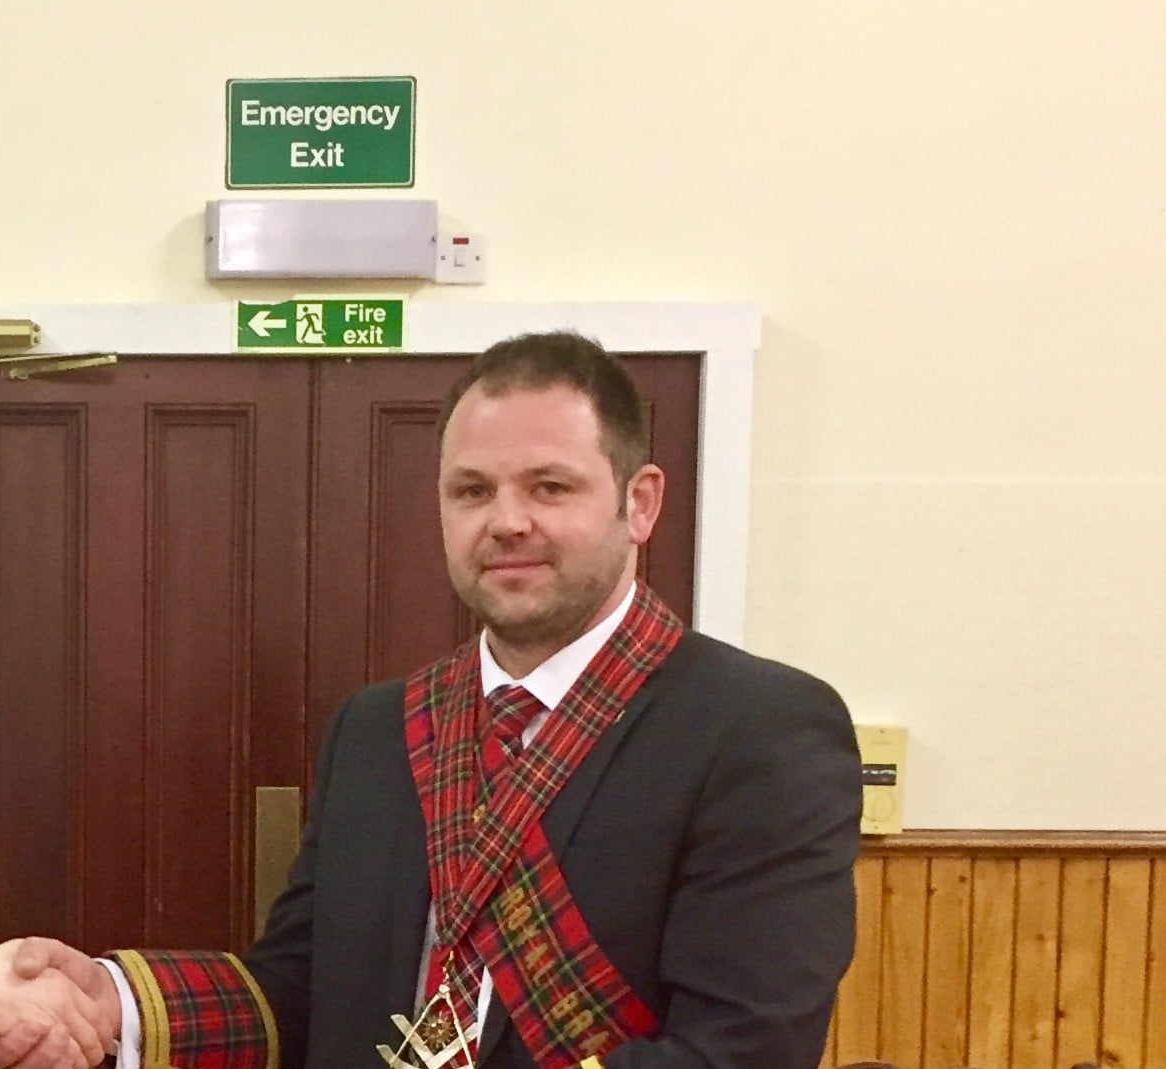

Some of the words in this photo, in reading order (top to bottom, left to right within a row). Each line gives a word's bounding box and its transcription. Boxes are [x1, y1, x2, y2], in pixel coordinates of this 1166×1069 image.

[241, 100, 400, 131] Emergency
[290, 142, 345, 167] Exit
[345, 304, 386, 323] Fire
[343, 326, 383, 344] exit
